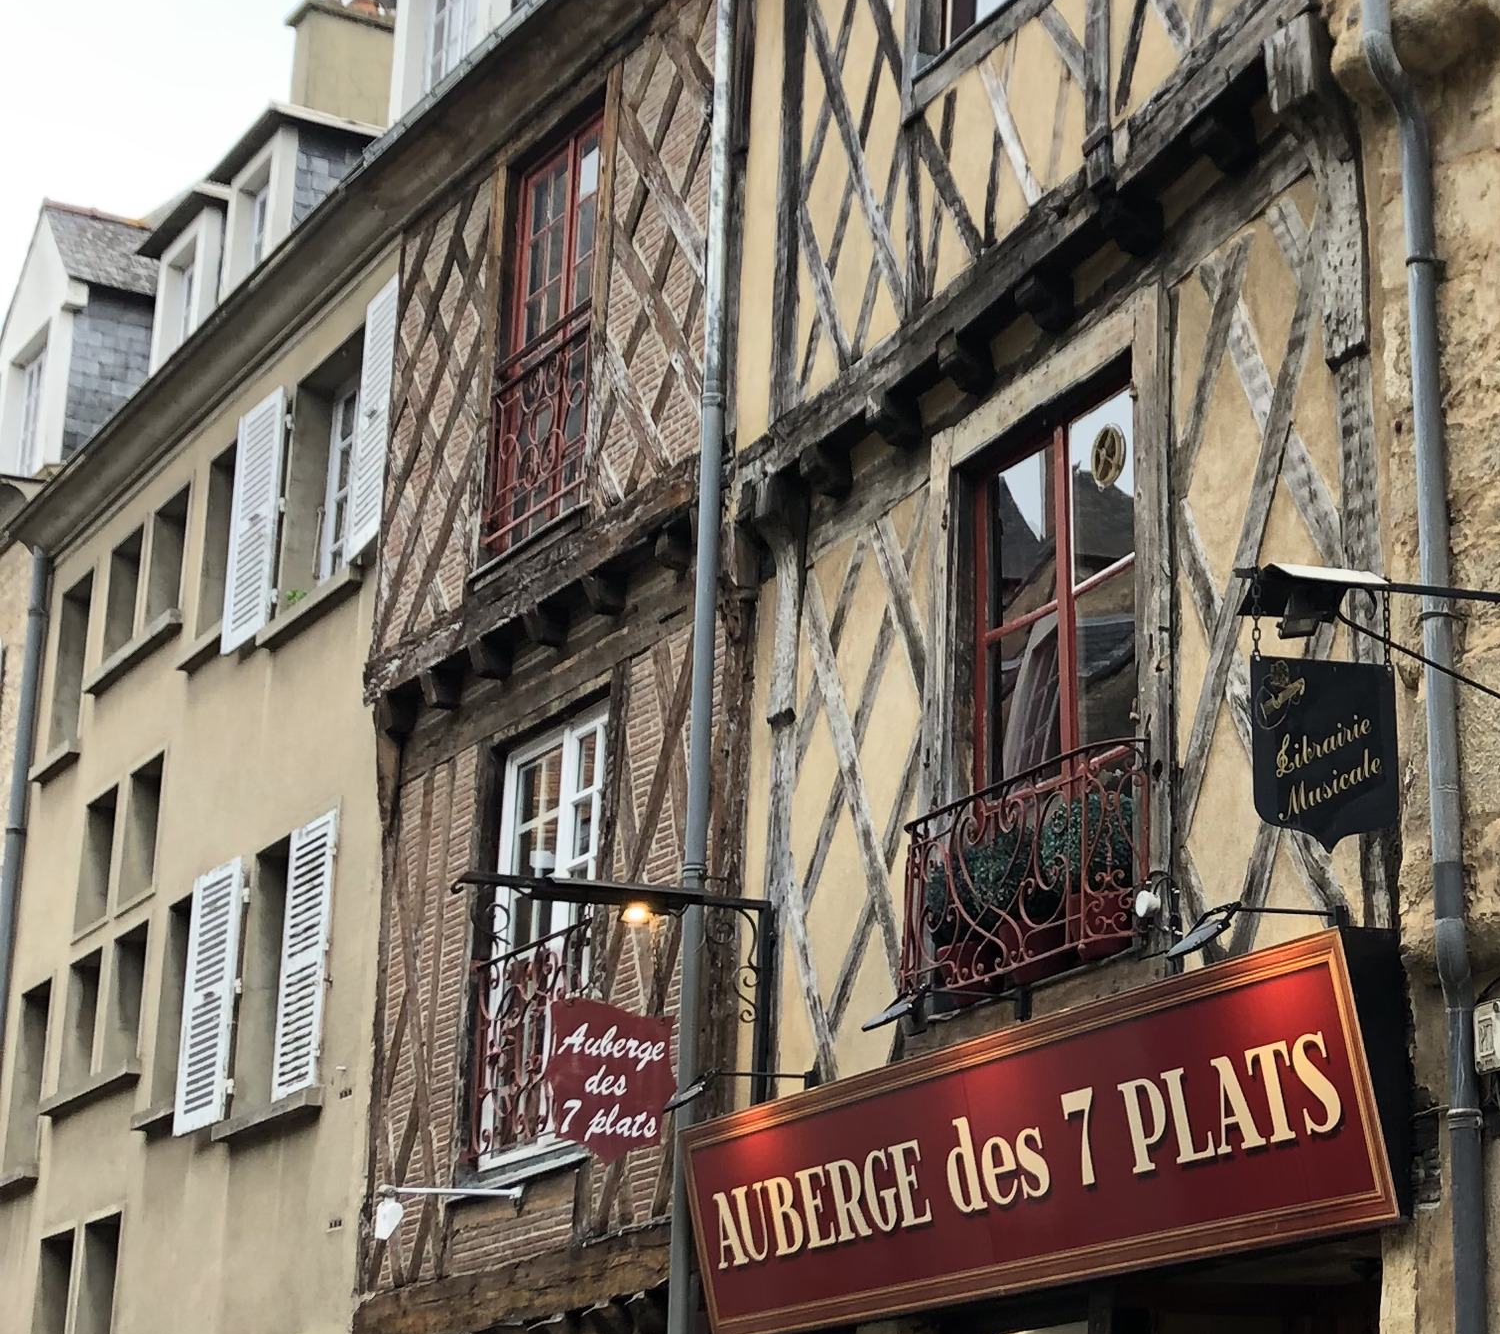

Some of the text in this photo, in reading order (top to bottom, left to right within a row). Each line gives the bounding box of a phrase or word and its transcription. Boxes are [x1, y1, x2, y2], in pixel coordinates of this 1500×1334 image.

[1276, 714, 1372, 778] Librairie
[1279, 749, 1382, 822] Musicale
[557, 1022, 666, 1072] Auberge
[584, 1065, 628, 1096] des
[560, 1099, 658, 1142] 7 plats
[712, 1031, 1344, 1270] AUBERGE des 7 PLATS
